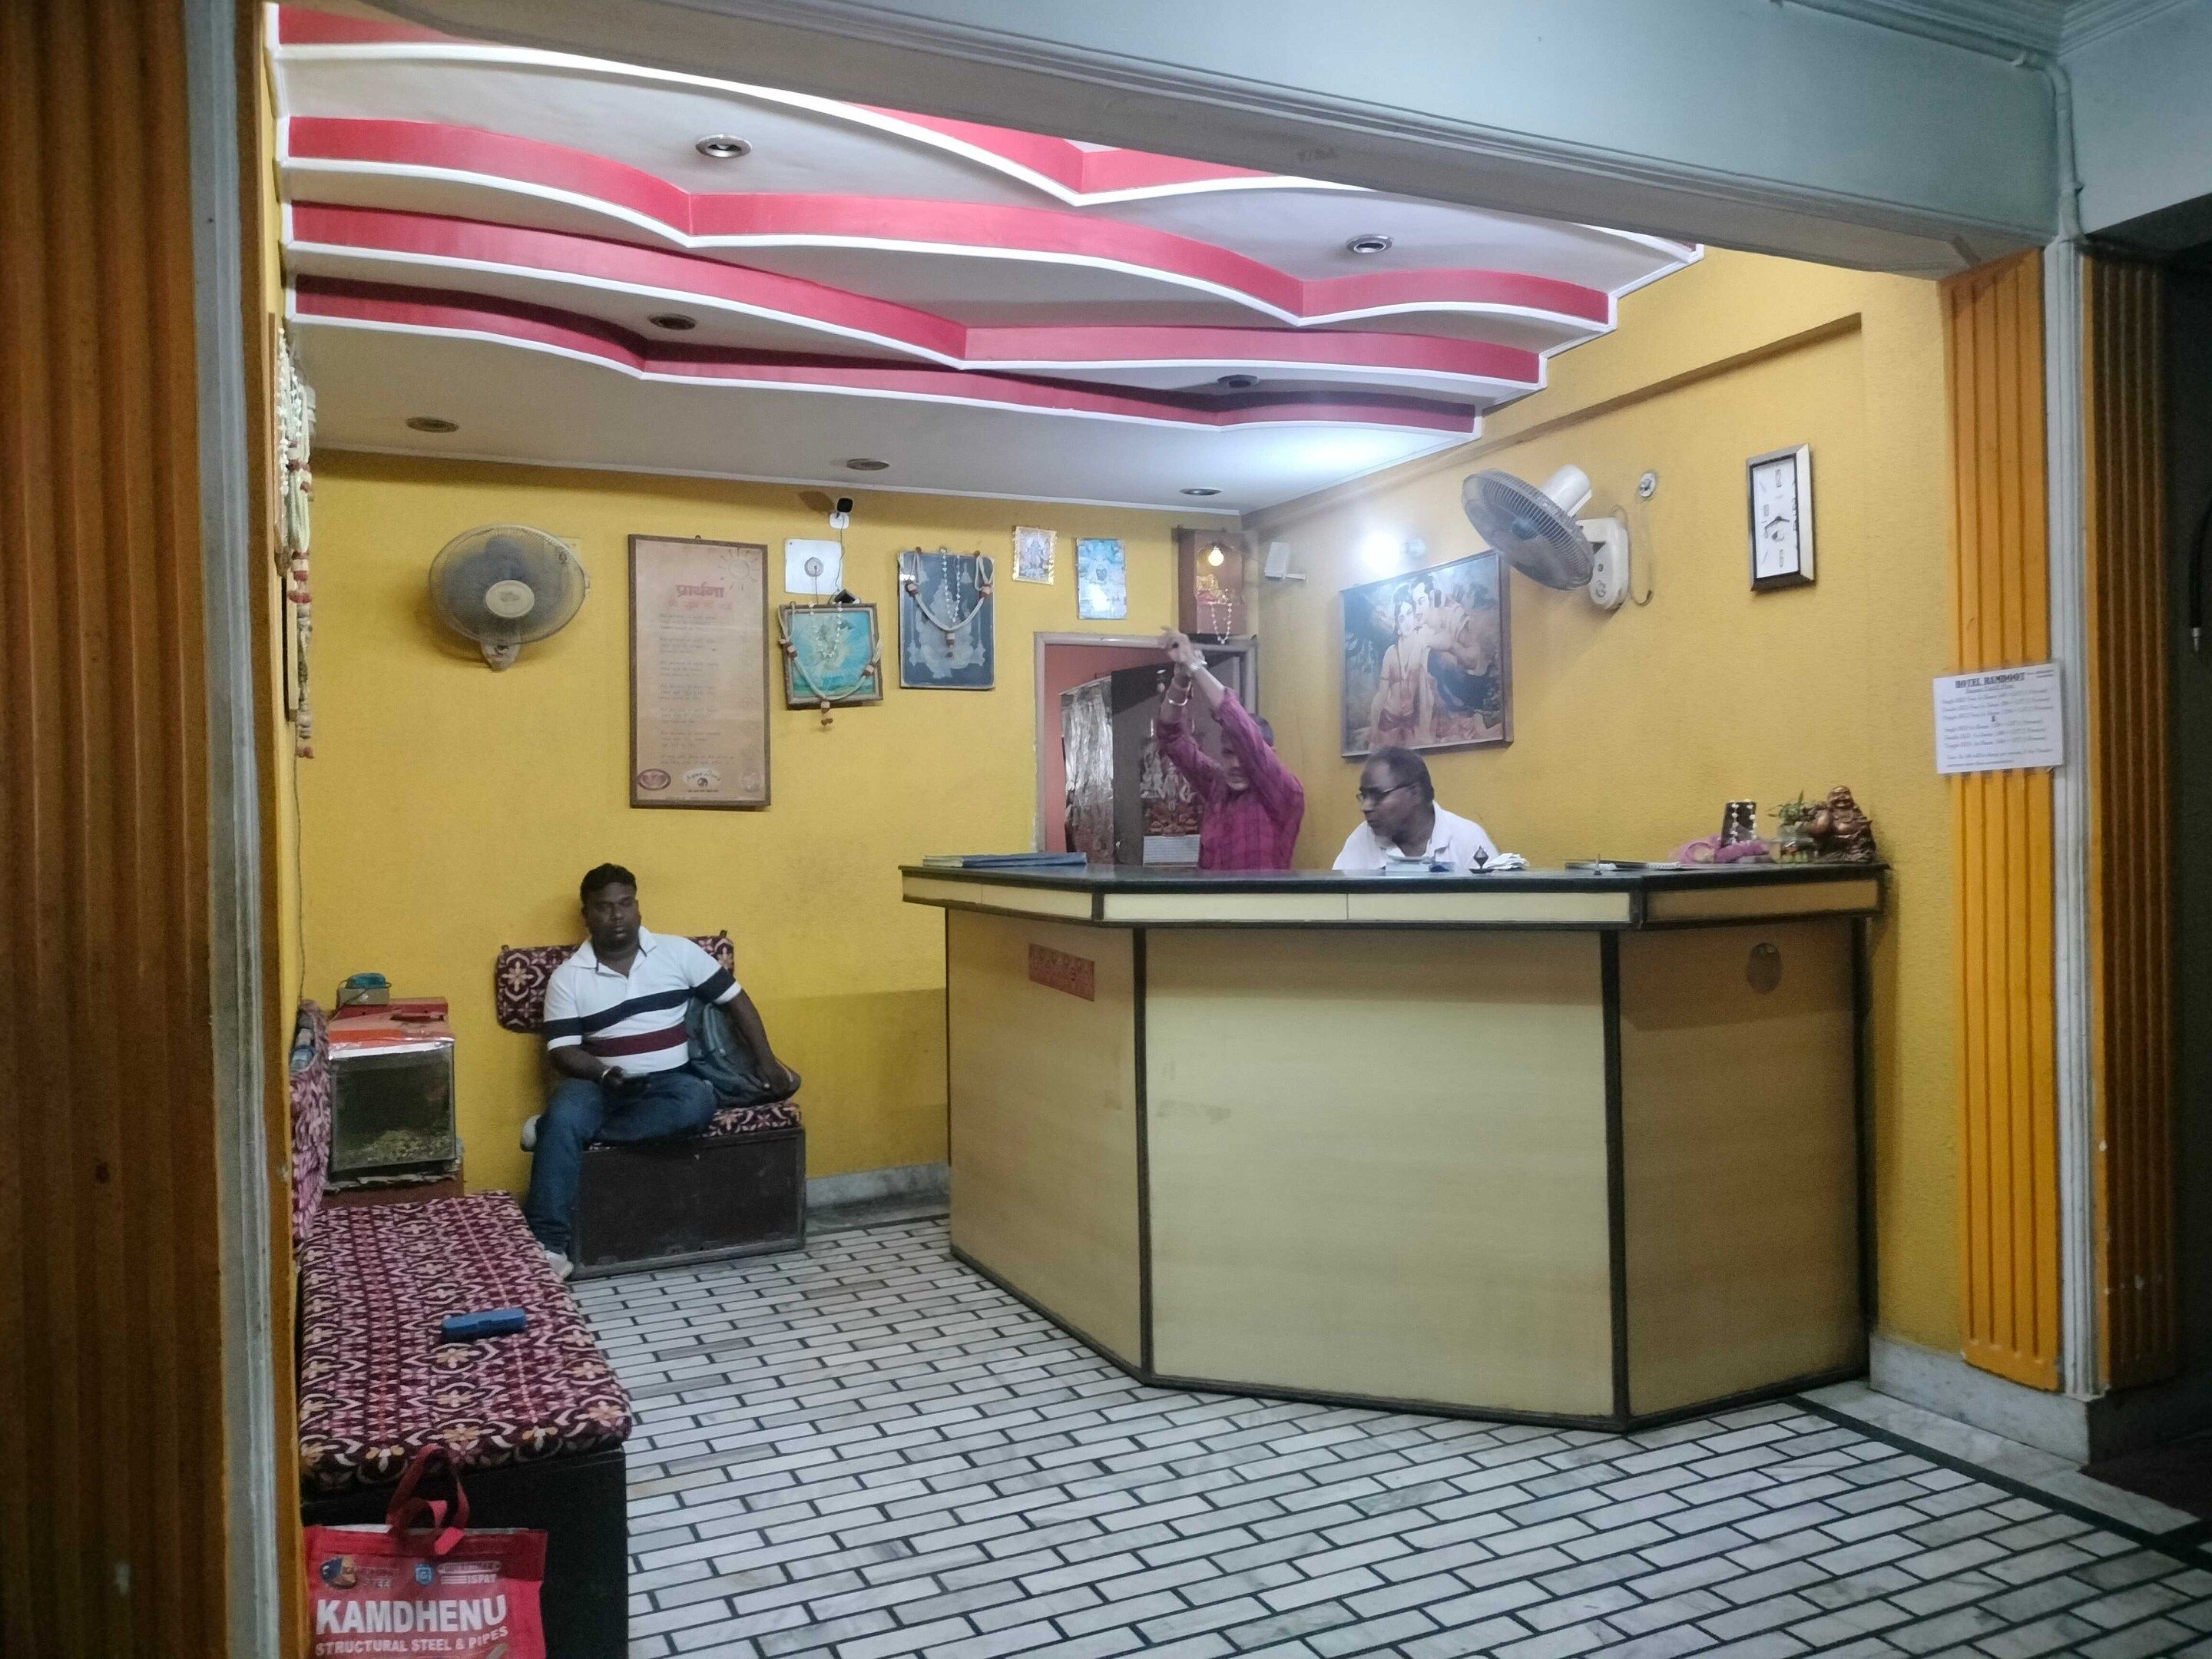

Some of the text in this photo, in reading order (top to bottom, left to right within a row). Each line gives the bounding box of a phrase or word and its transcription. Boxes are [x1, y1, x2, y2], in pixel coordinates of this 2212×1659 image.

[1955, 678, 1980, 688] HOTEL
[316, 1594, 507, 1634] KAMDHENU
[315, 1626, 508, 1656] STRUCTURAL STEEL & PIPES
